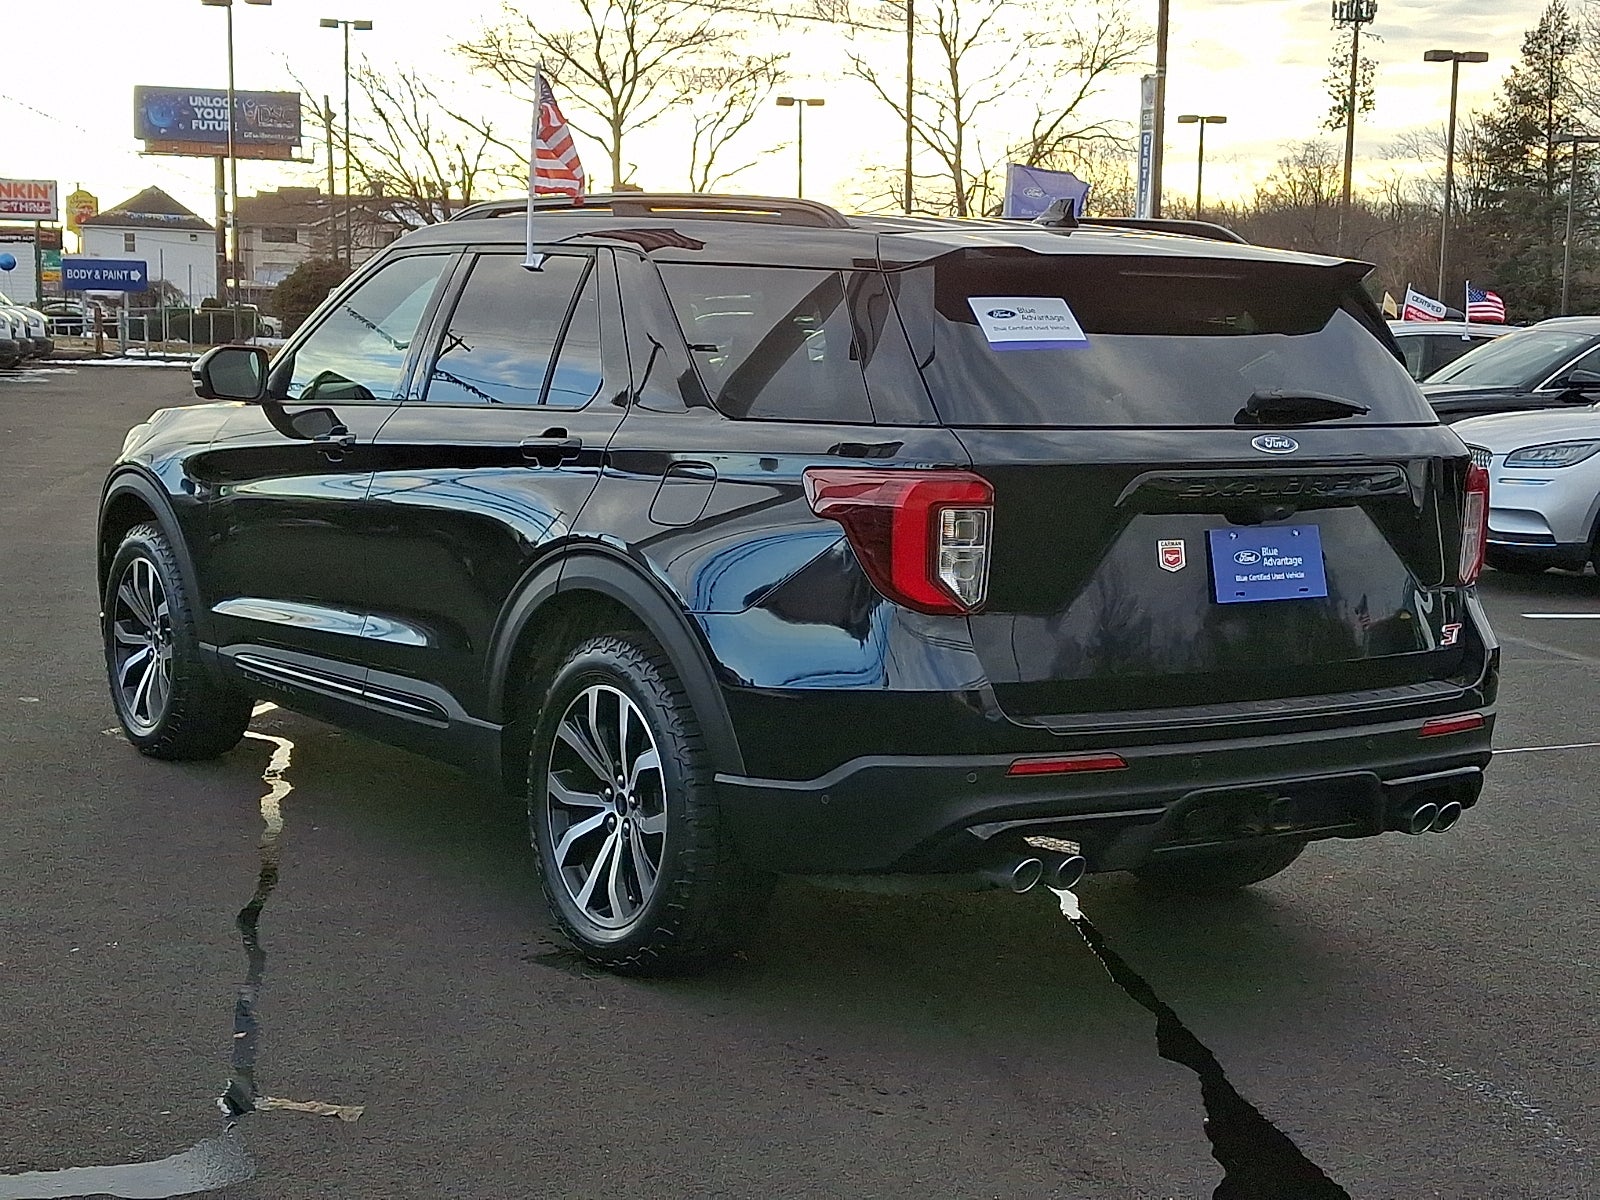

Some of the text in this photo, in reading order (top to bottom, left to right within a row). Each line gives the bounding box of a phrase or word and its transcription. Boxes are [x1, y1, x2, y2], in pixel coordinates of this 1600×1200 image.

[66, 268, 129, 281] BODY & PAINT
[1411, 295, 1443, 313] CERTIFIED
[1021, 314, 1065, 322] Advantage
[1261, 547, 1278, 556] Blue
[1263, 556, 1303, 567] Advantage
[1235, 574, 1248, 582] Blue
[1249, 573, 1271, 581] Certified
[1440, 622, 1463, 646] ST
